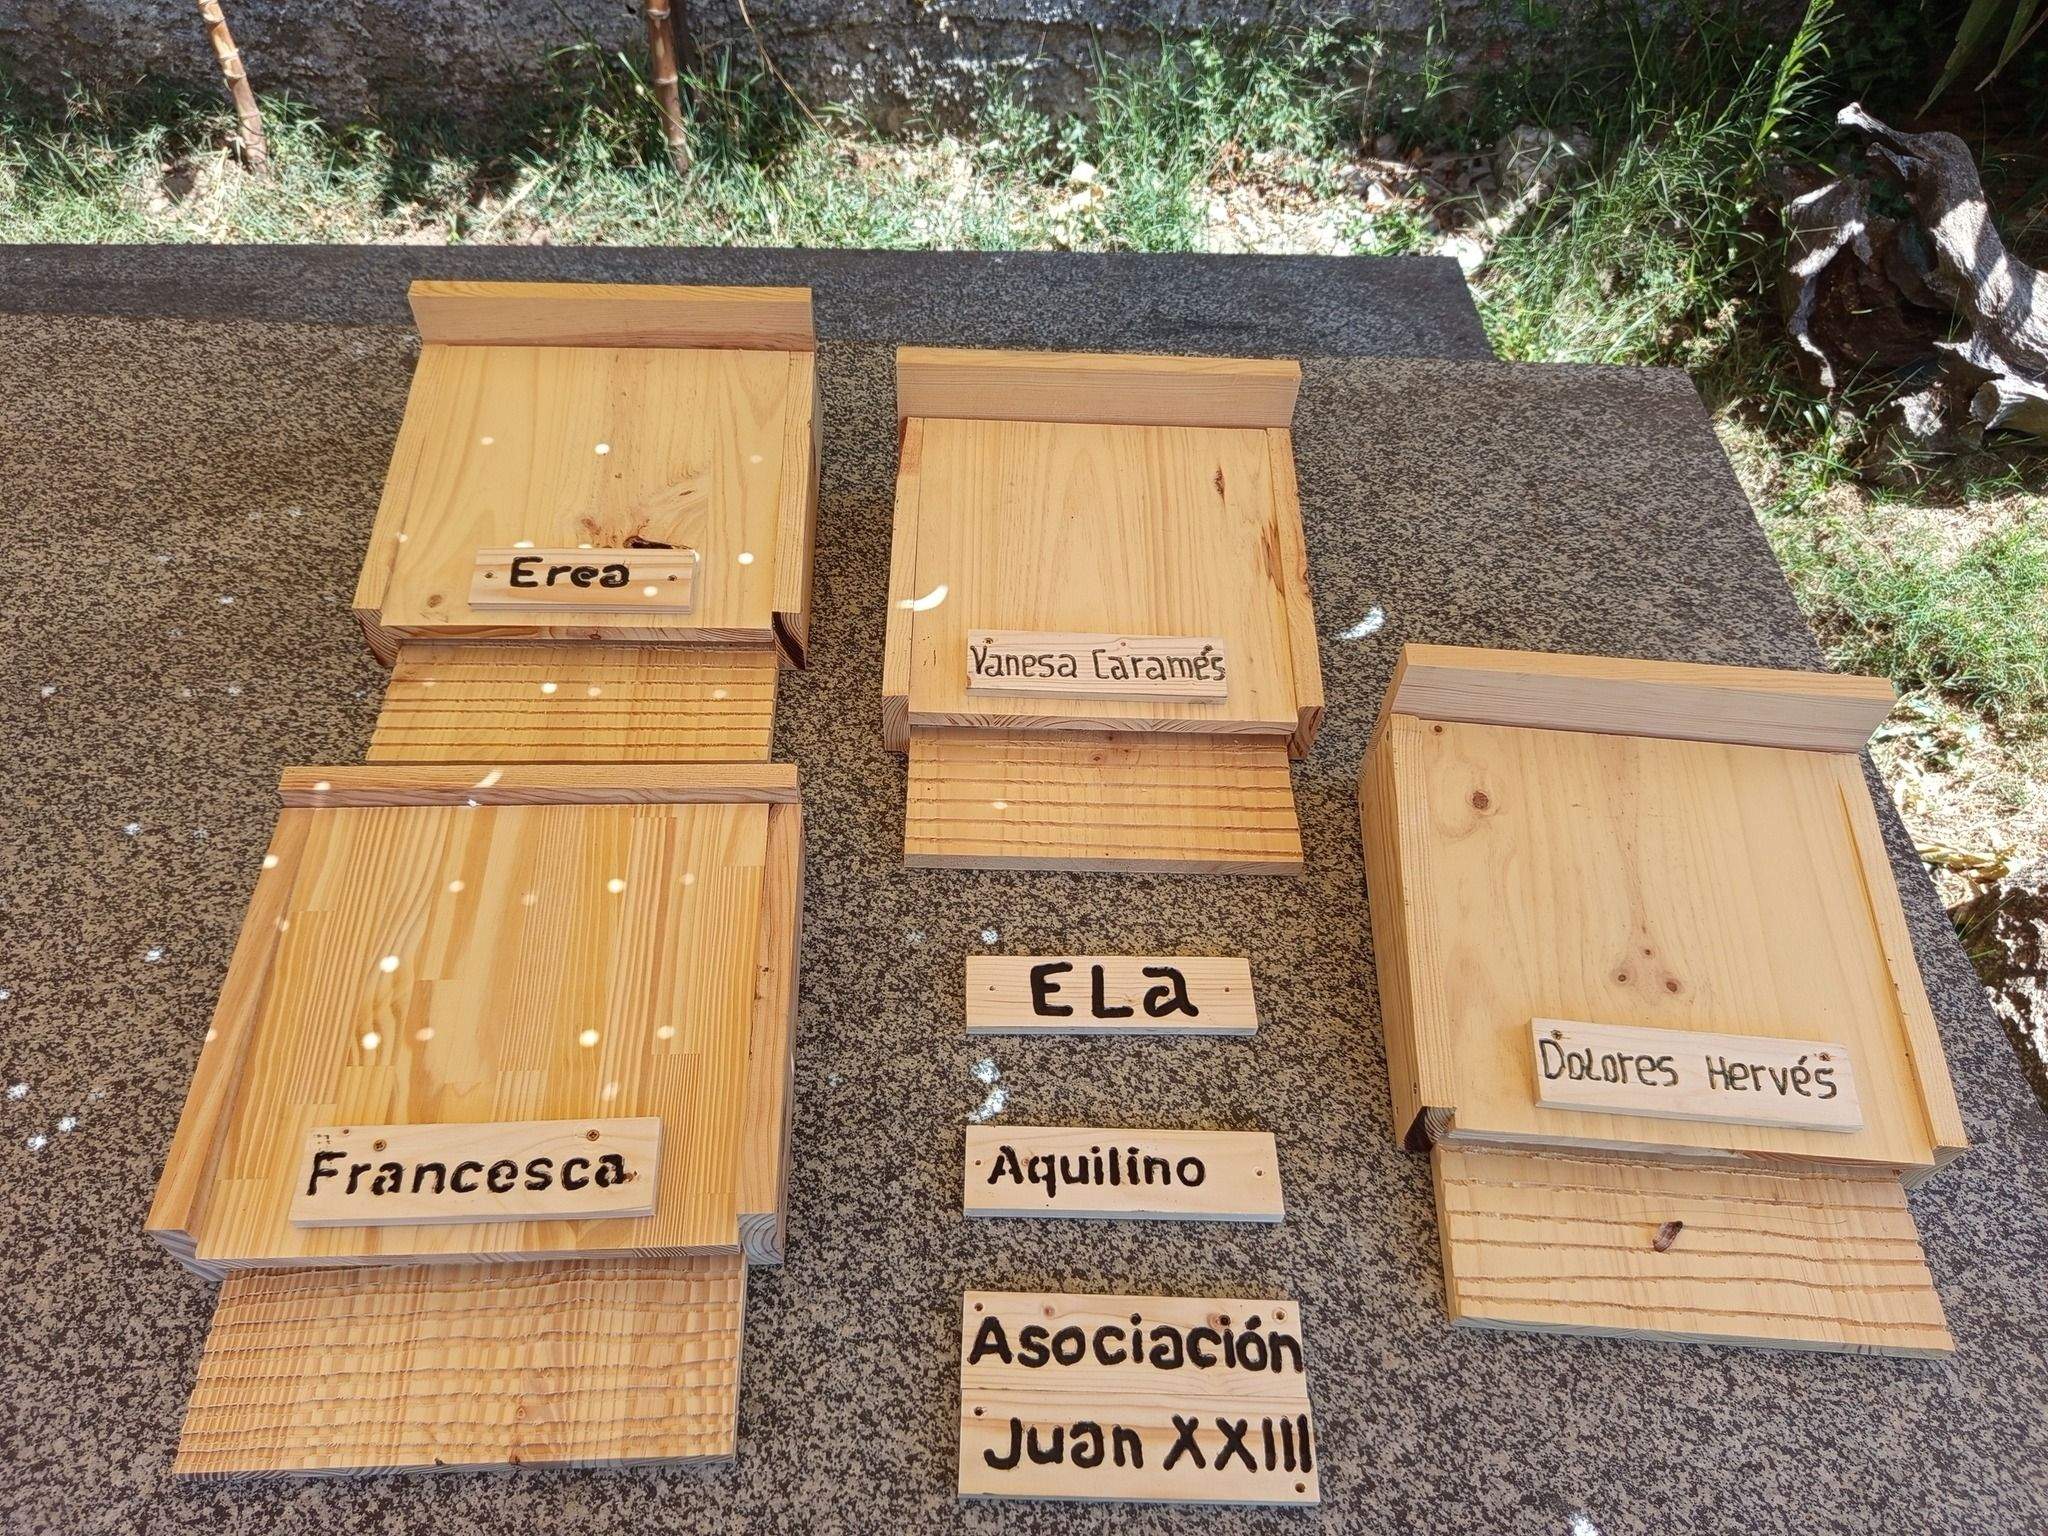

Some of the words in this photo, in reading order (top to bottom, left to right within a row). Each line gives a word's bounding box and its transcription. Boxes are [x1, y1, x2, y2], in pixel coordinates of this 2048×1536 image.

[509, 555, 631, 589] Erea
[969, 645, 1078, 679] Vanesa
[1092, 648, 1226, 681] Caramés
[1704, 1055, 1838, 1100] Hervés
[305, 1150, 628, 1197] Francesca
[987, 1145, 1206, 1199] Aquilino
[967, 1312, 1304, 1374] Asociación
[983, 1416, 1144, 1471] Juan
[1162, 1413, 1313, 1474] XXIII
